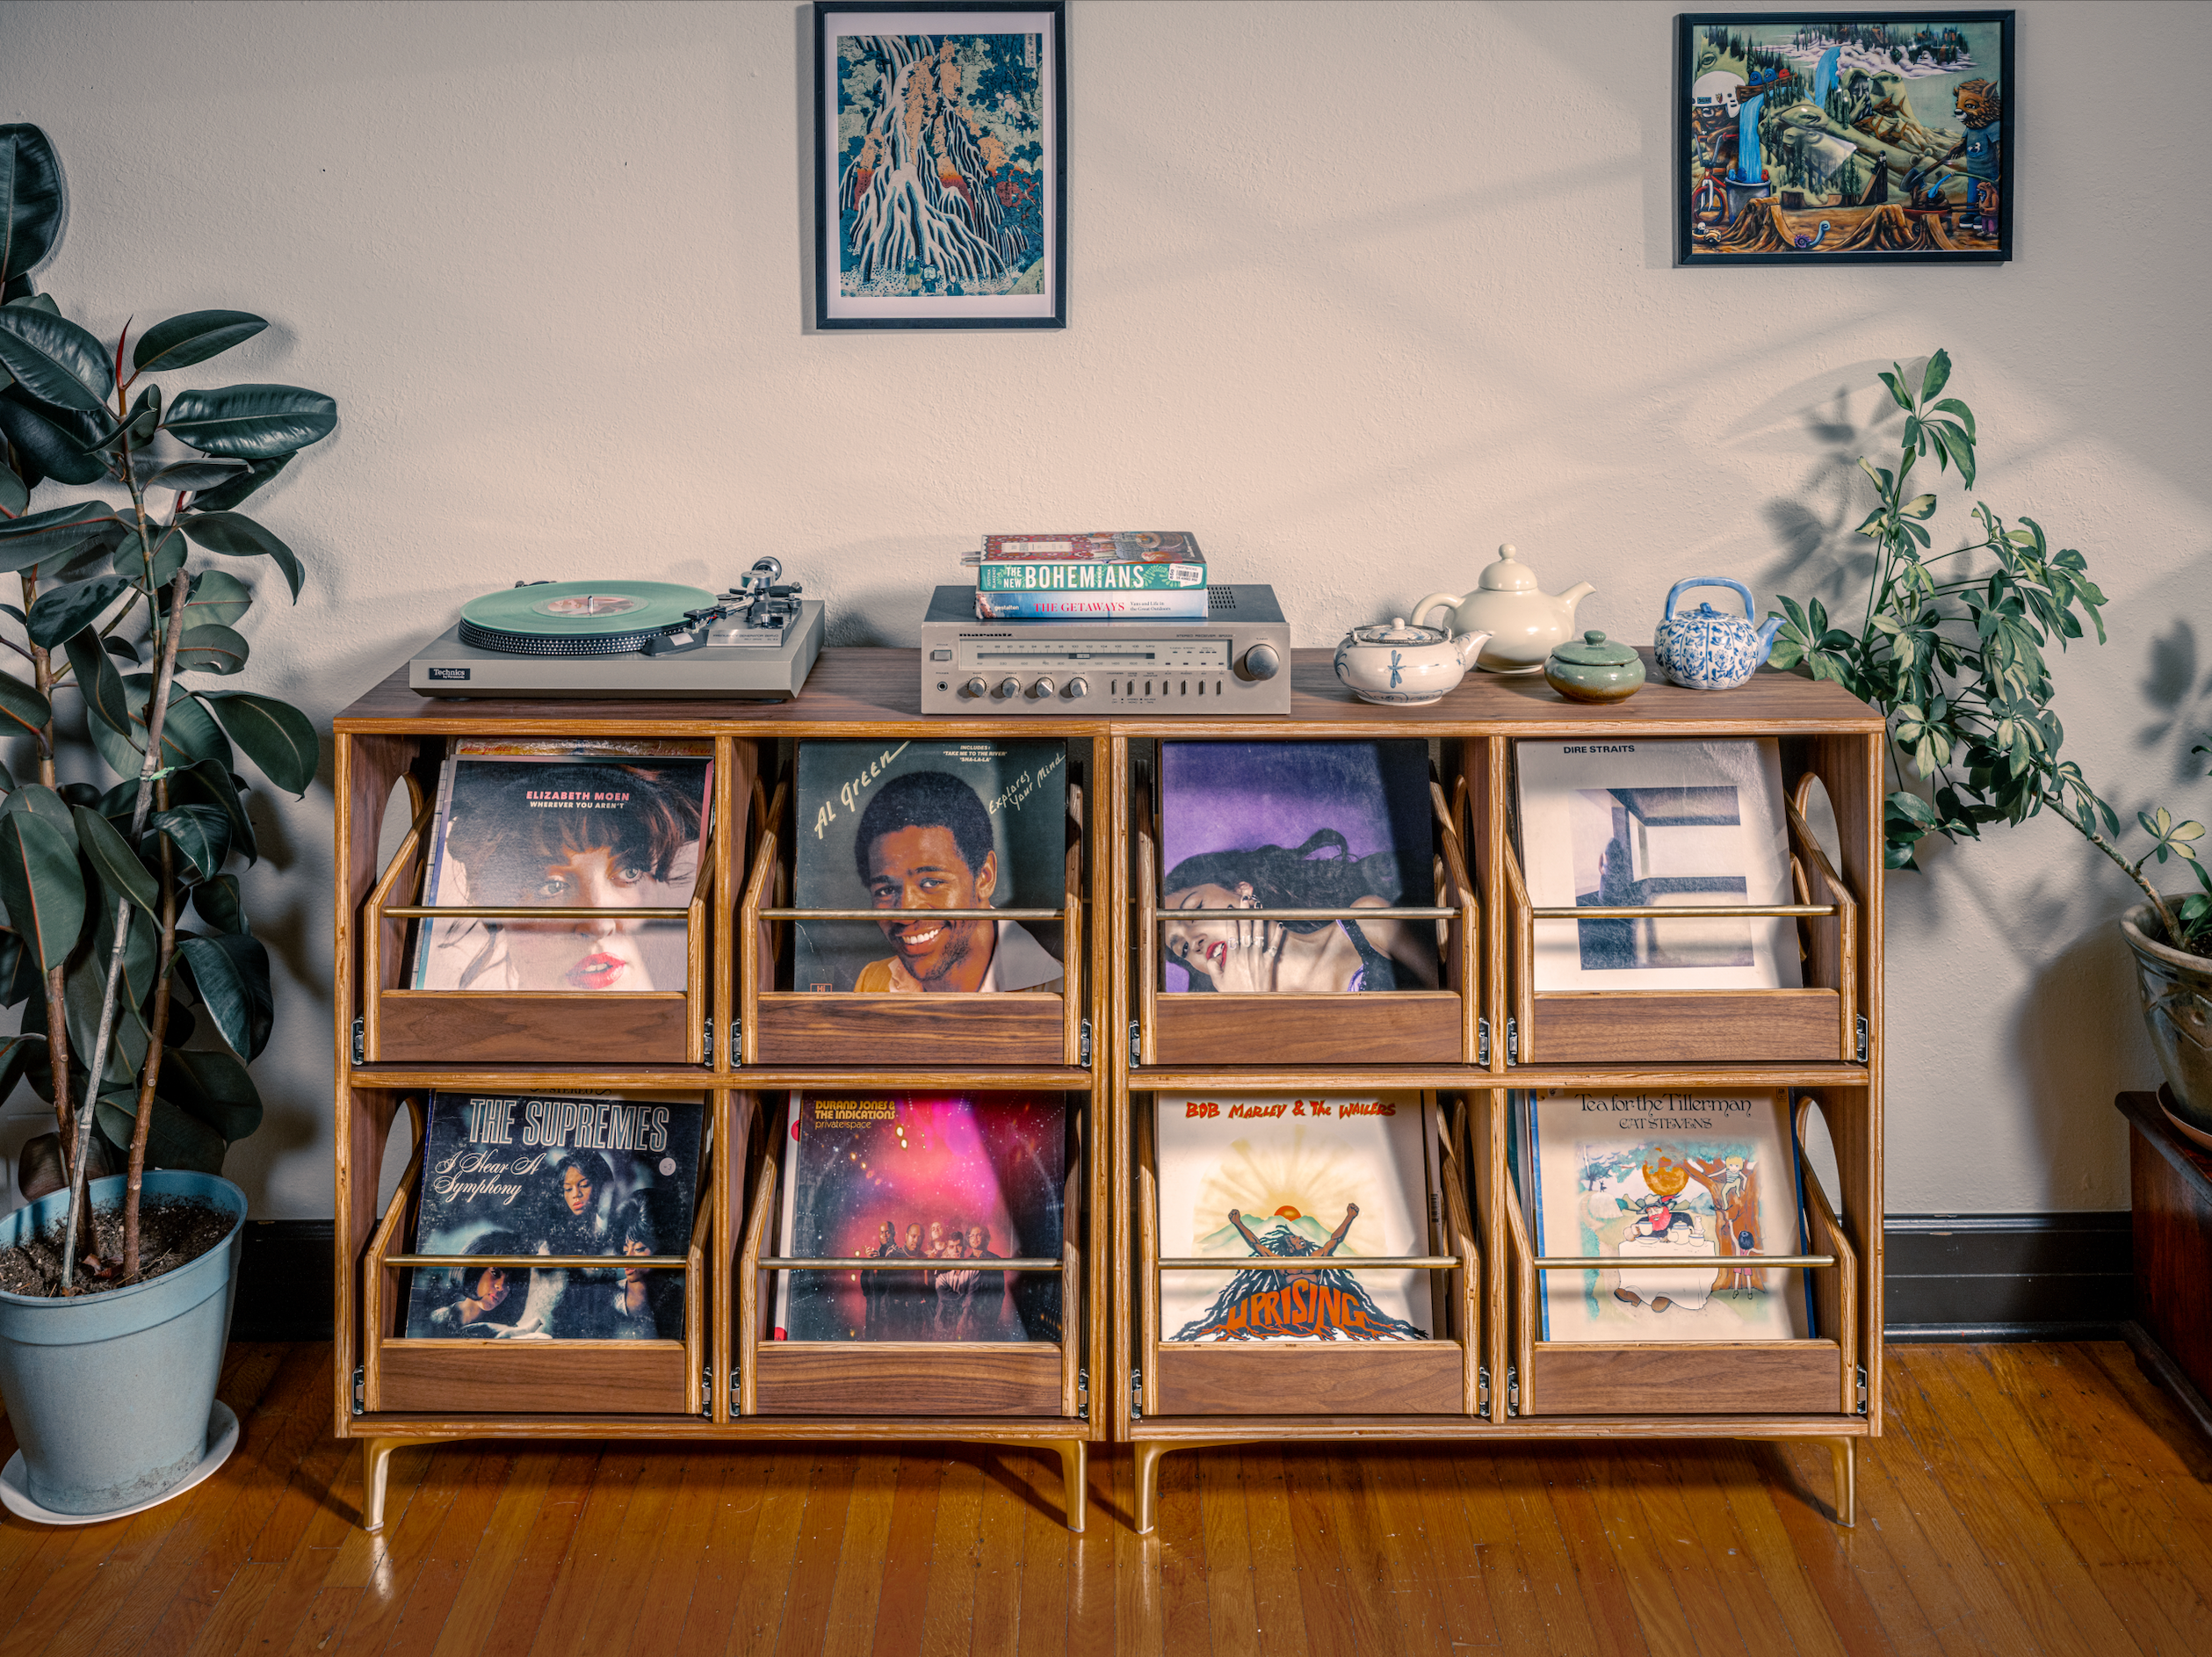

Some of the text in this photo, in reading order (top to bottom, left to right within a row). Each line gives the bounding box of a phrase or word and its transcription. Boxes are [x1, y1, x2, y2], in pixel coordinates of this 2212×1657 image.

[1006, 567, 1022, 577] THE
[1025, 565, 1145, 589] BOHEMIANS
[1003, 578, 1022, 589] NEW
[1033, 602, 1124, 612] THE GETAWAYS
[682, 743, 712, 755] Seven
[1588, 744, 1635, 753] STRAITS
[525, 791, 630, 801] ELIZABETH MOEN
[815, 1100, 896, 1111] DURAND JONES &
[1186, 1102, 1220, 1118] BOB
[1228, 1103, 1287, 1119] MARLEY
[1292, 1099, 1306, 1117] &
[1339, 1102, 1397, 1119] WAILERS
[1574, 1093, 1752, 1118] Tea for the Tillerman
[814, 1110, 896, 1120] THE INDICATIONS
[469, 1098, 670, 1153] THE SUPREMES
[814, 1120, 871, 1131] private space
[1619, 1118, 1713, 1130] CAT STEVENS
[459, 1148, 510, 1173] Hear
[510, 1152, 546, 1176] A
[433, 1170, 522, 1205] Symphony
[1225, 1278, 1367, 1329] UPRISING
